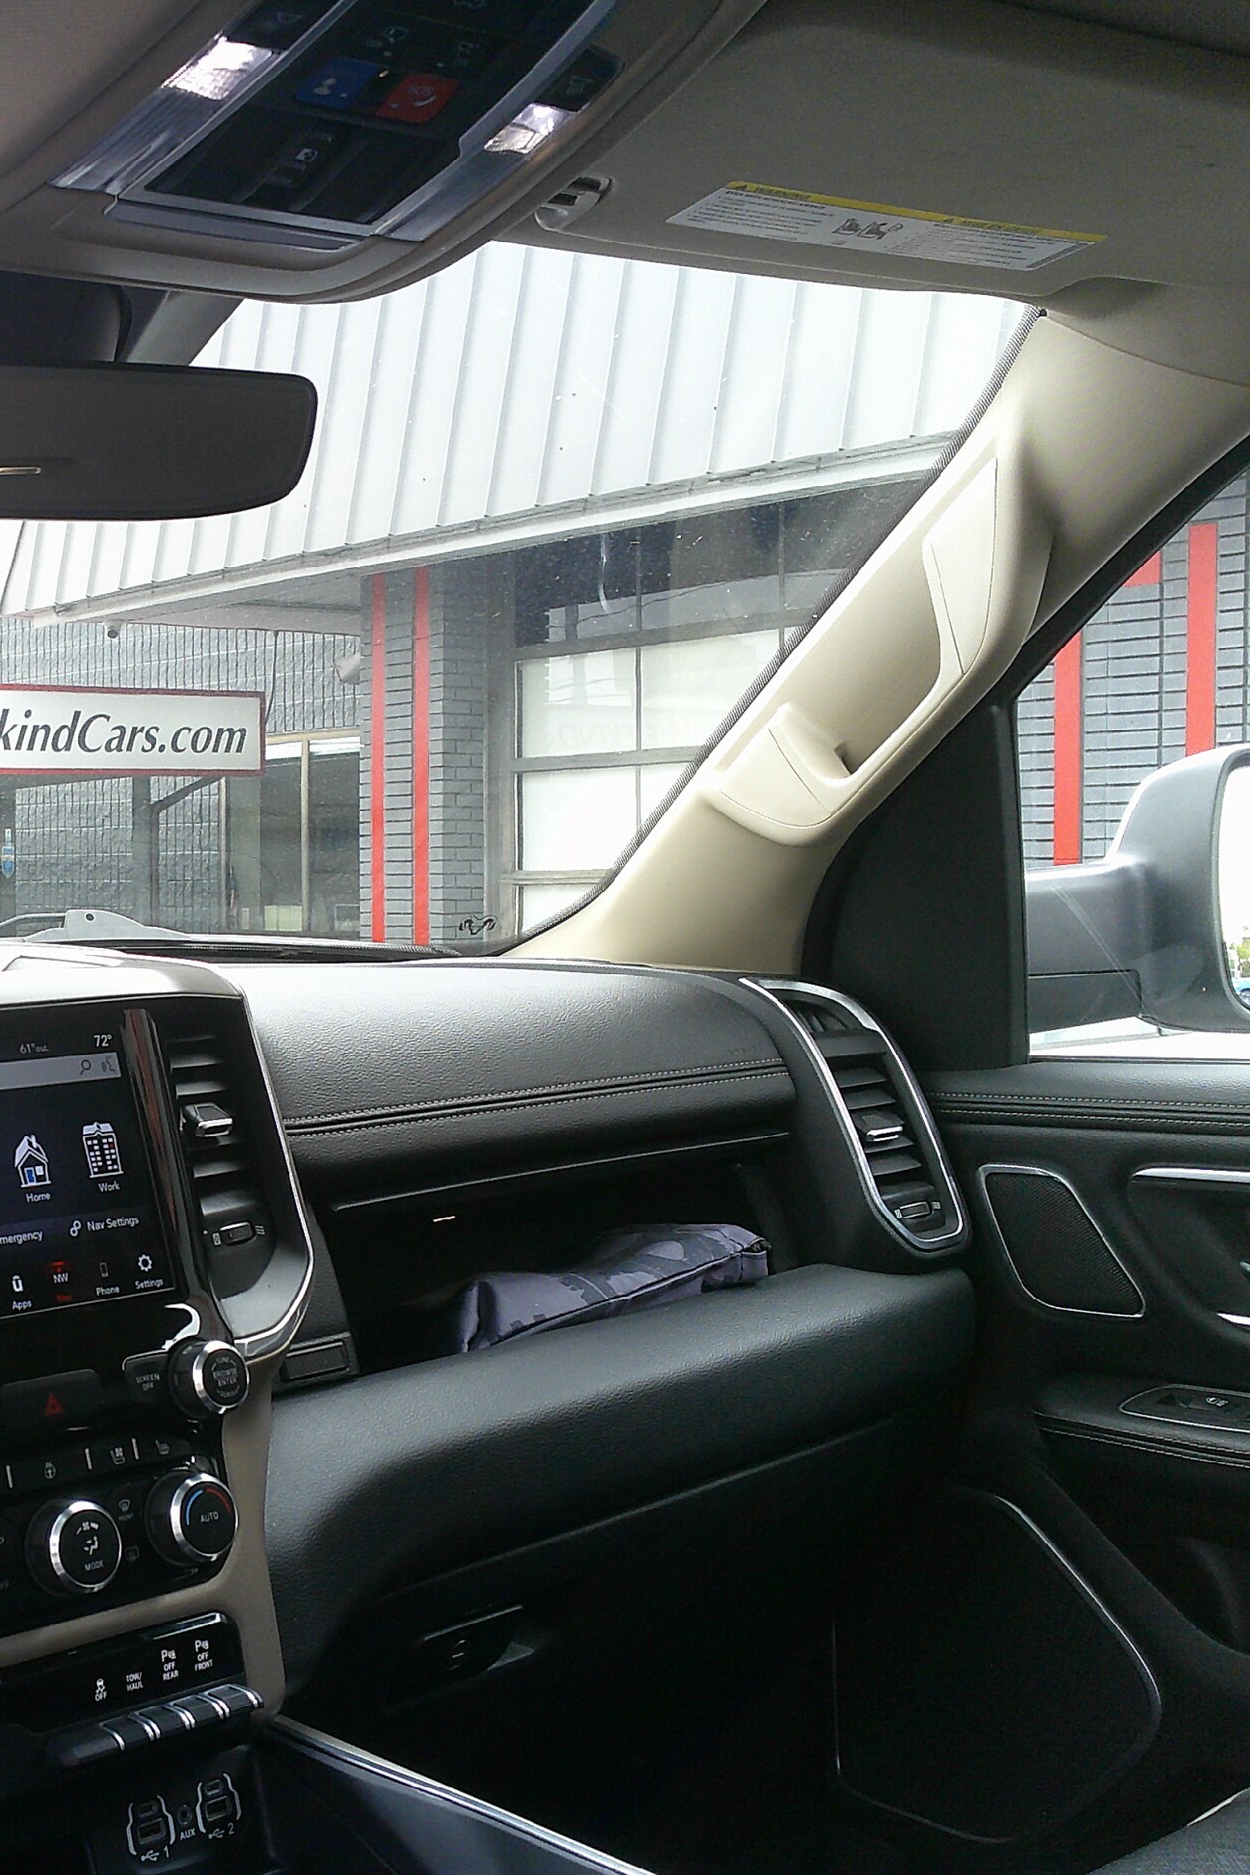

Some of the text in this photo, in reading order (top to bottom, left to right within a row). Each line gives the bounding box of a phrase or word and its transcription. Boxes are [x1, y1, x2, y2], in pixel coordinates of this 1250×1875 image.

[98, 1181, 121, 1192] Work
[26, 1191, 51, 1203] Home
[87, 1214, 140, 1232] Nav Settings
[52, 1272, 69, 1284] NW
[135, 1279, 164, 1290] Settings
[95, 1286, 120, 1296] Phone
[12, 1299, 32, 1311] Apps
[200, 1511, 219, 1524] AUTO
[84, 1559, 104, 1571] MODE
[197, 1652, 209, 1662] OFF
[163, 1661, 176, 1671] OFF
[194, 1659, 213, 1671] FRONT
[162, 1670, 180, 1681] REAR
[126, 1681, 144, 1692] HAUL
[94, 1690, 108, 1702] OFF
[180, 1828, 197, 1841] AUX
